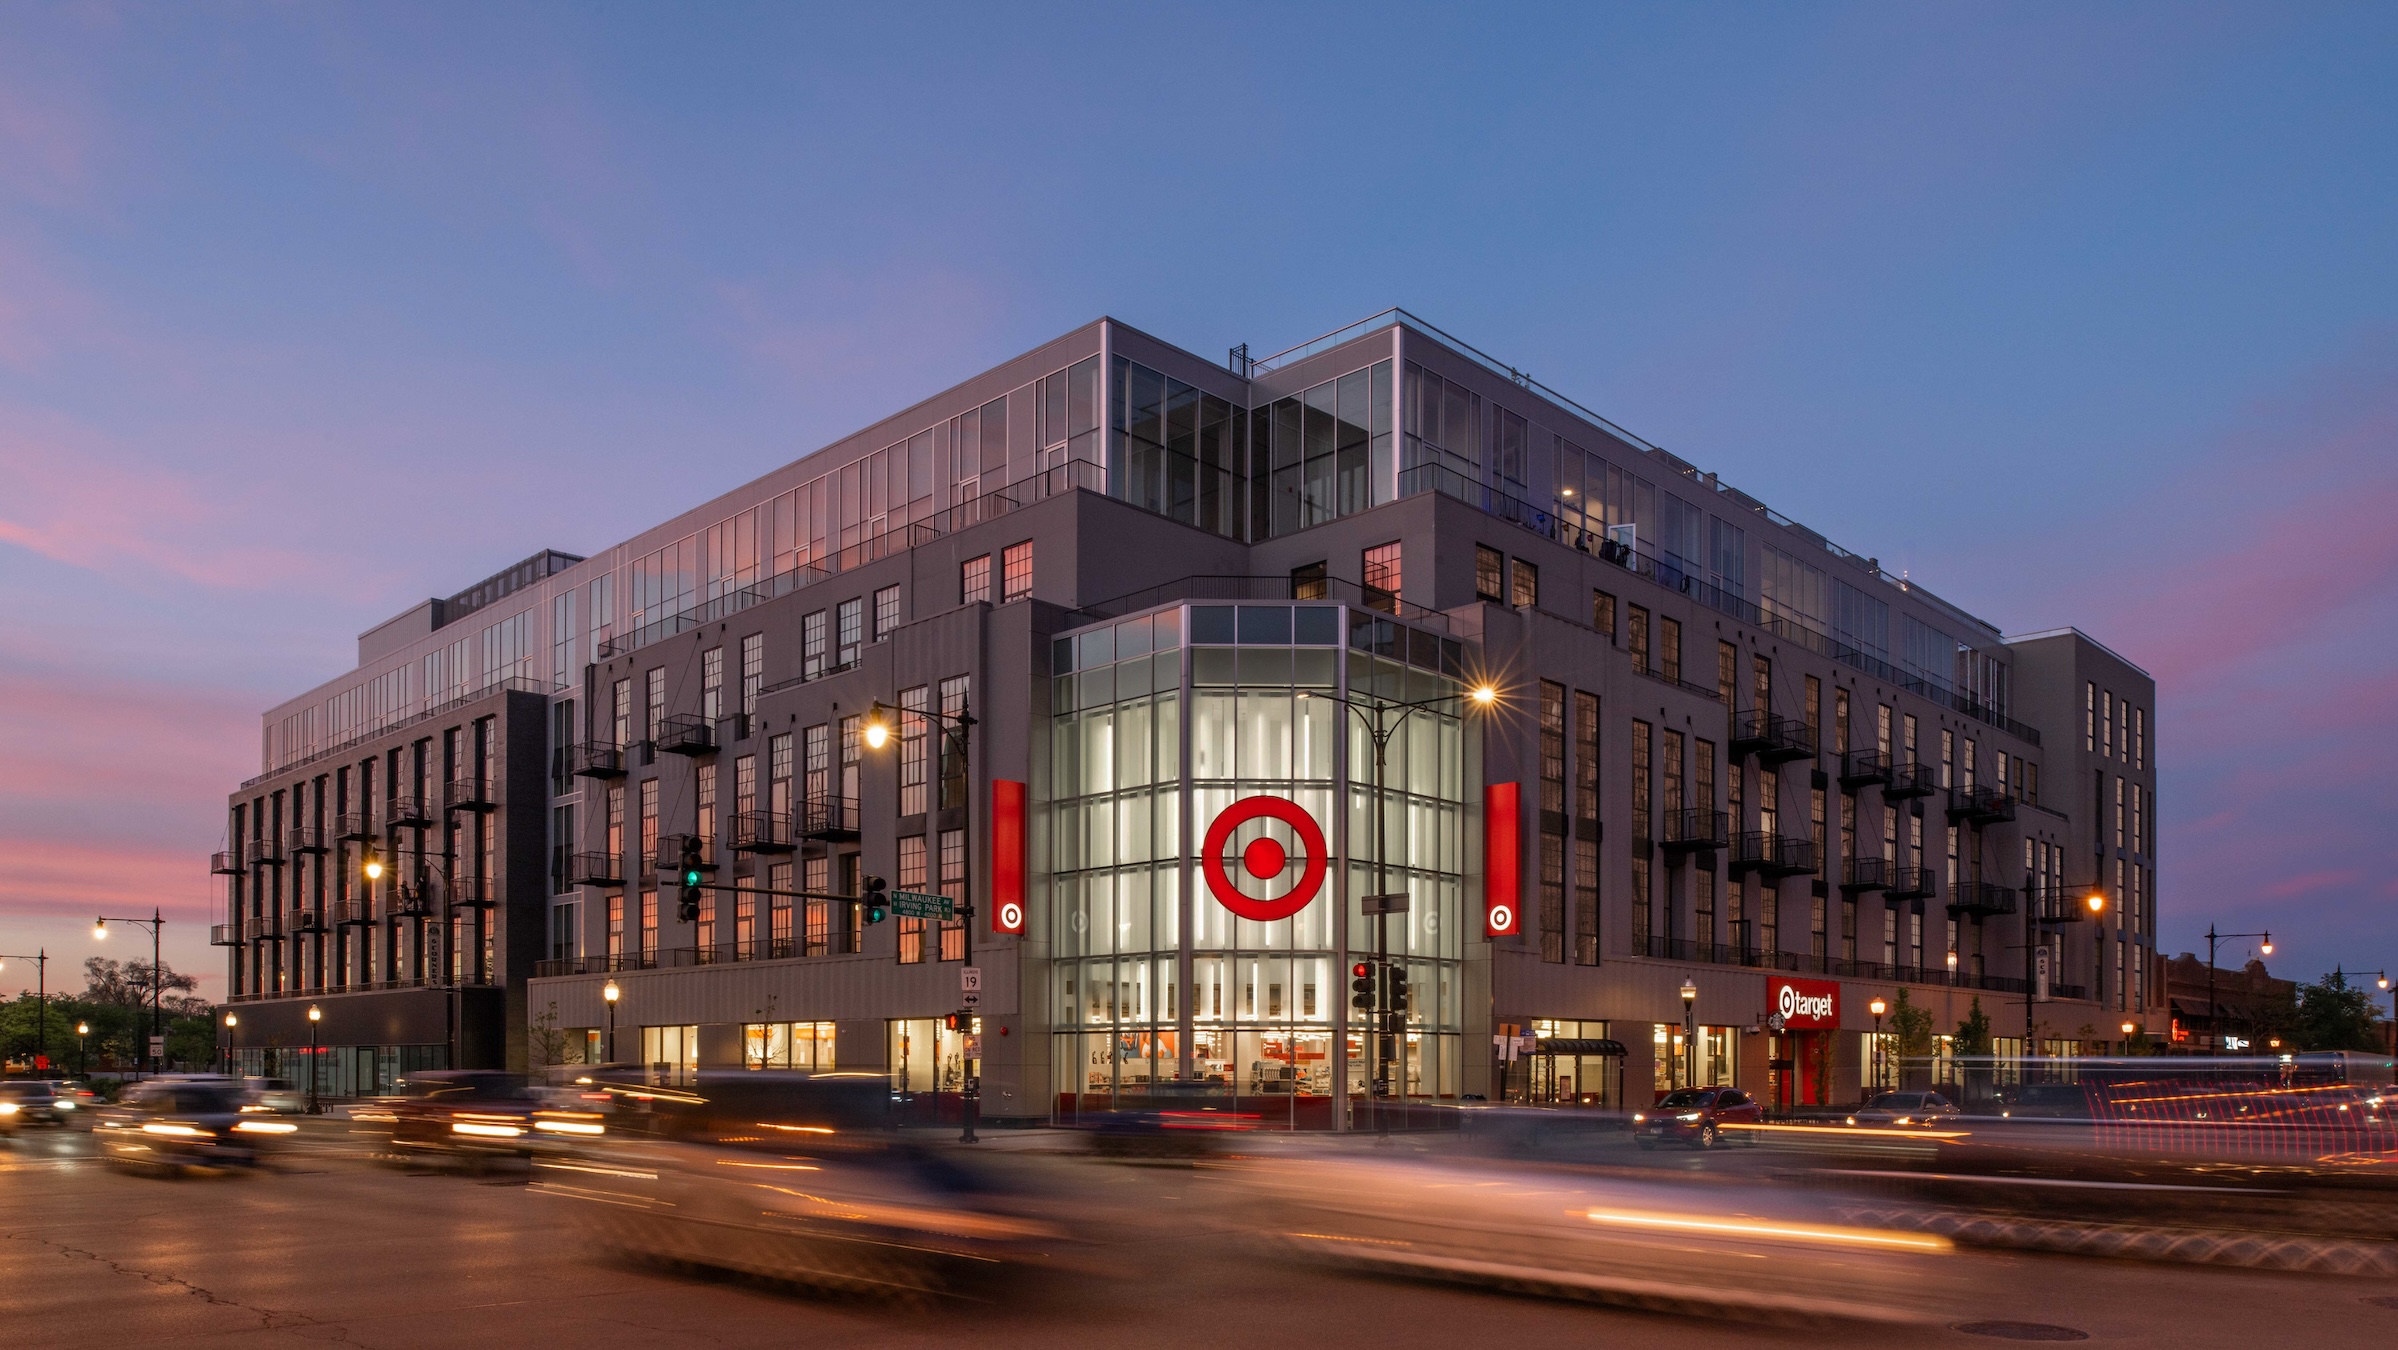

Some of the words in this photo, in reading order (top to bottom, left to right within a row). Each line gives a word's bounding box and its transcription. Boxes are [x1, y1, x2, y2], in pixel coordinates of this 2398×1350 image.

[899, 893, 941, 905] MILWAUKEE
[899, 901, 922, 910] IRVING
[924, 904, 942, 913] PARK
[966, 976, 977, 987] 19
[1795, 991, 1832, 1021] target
